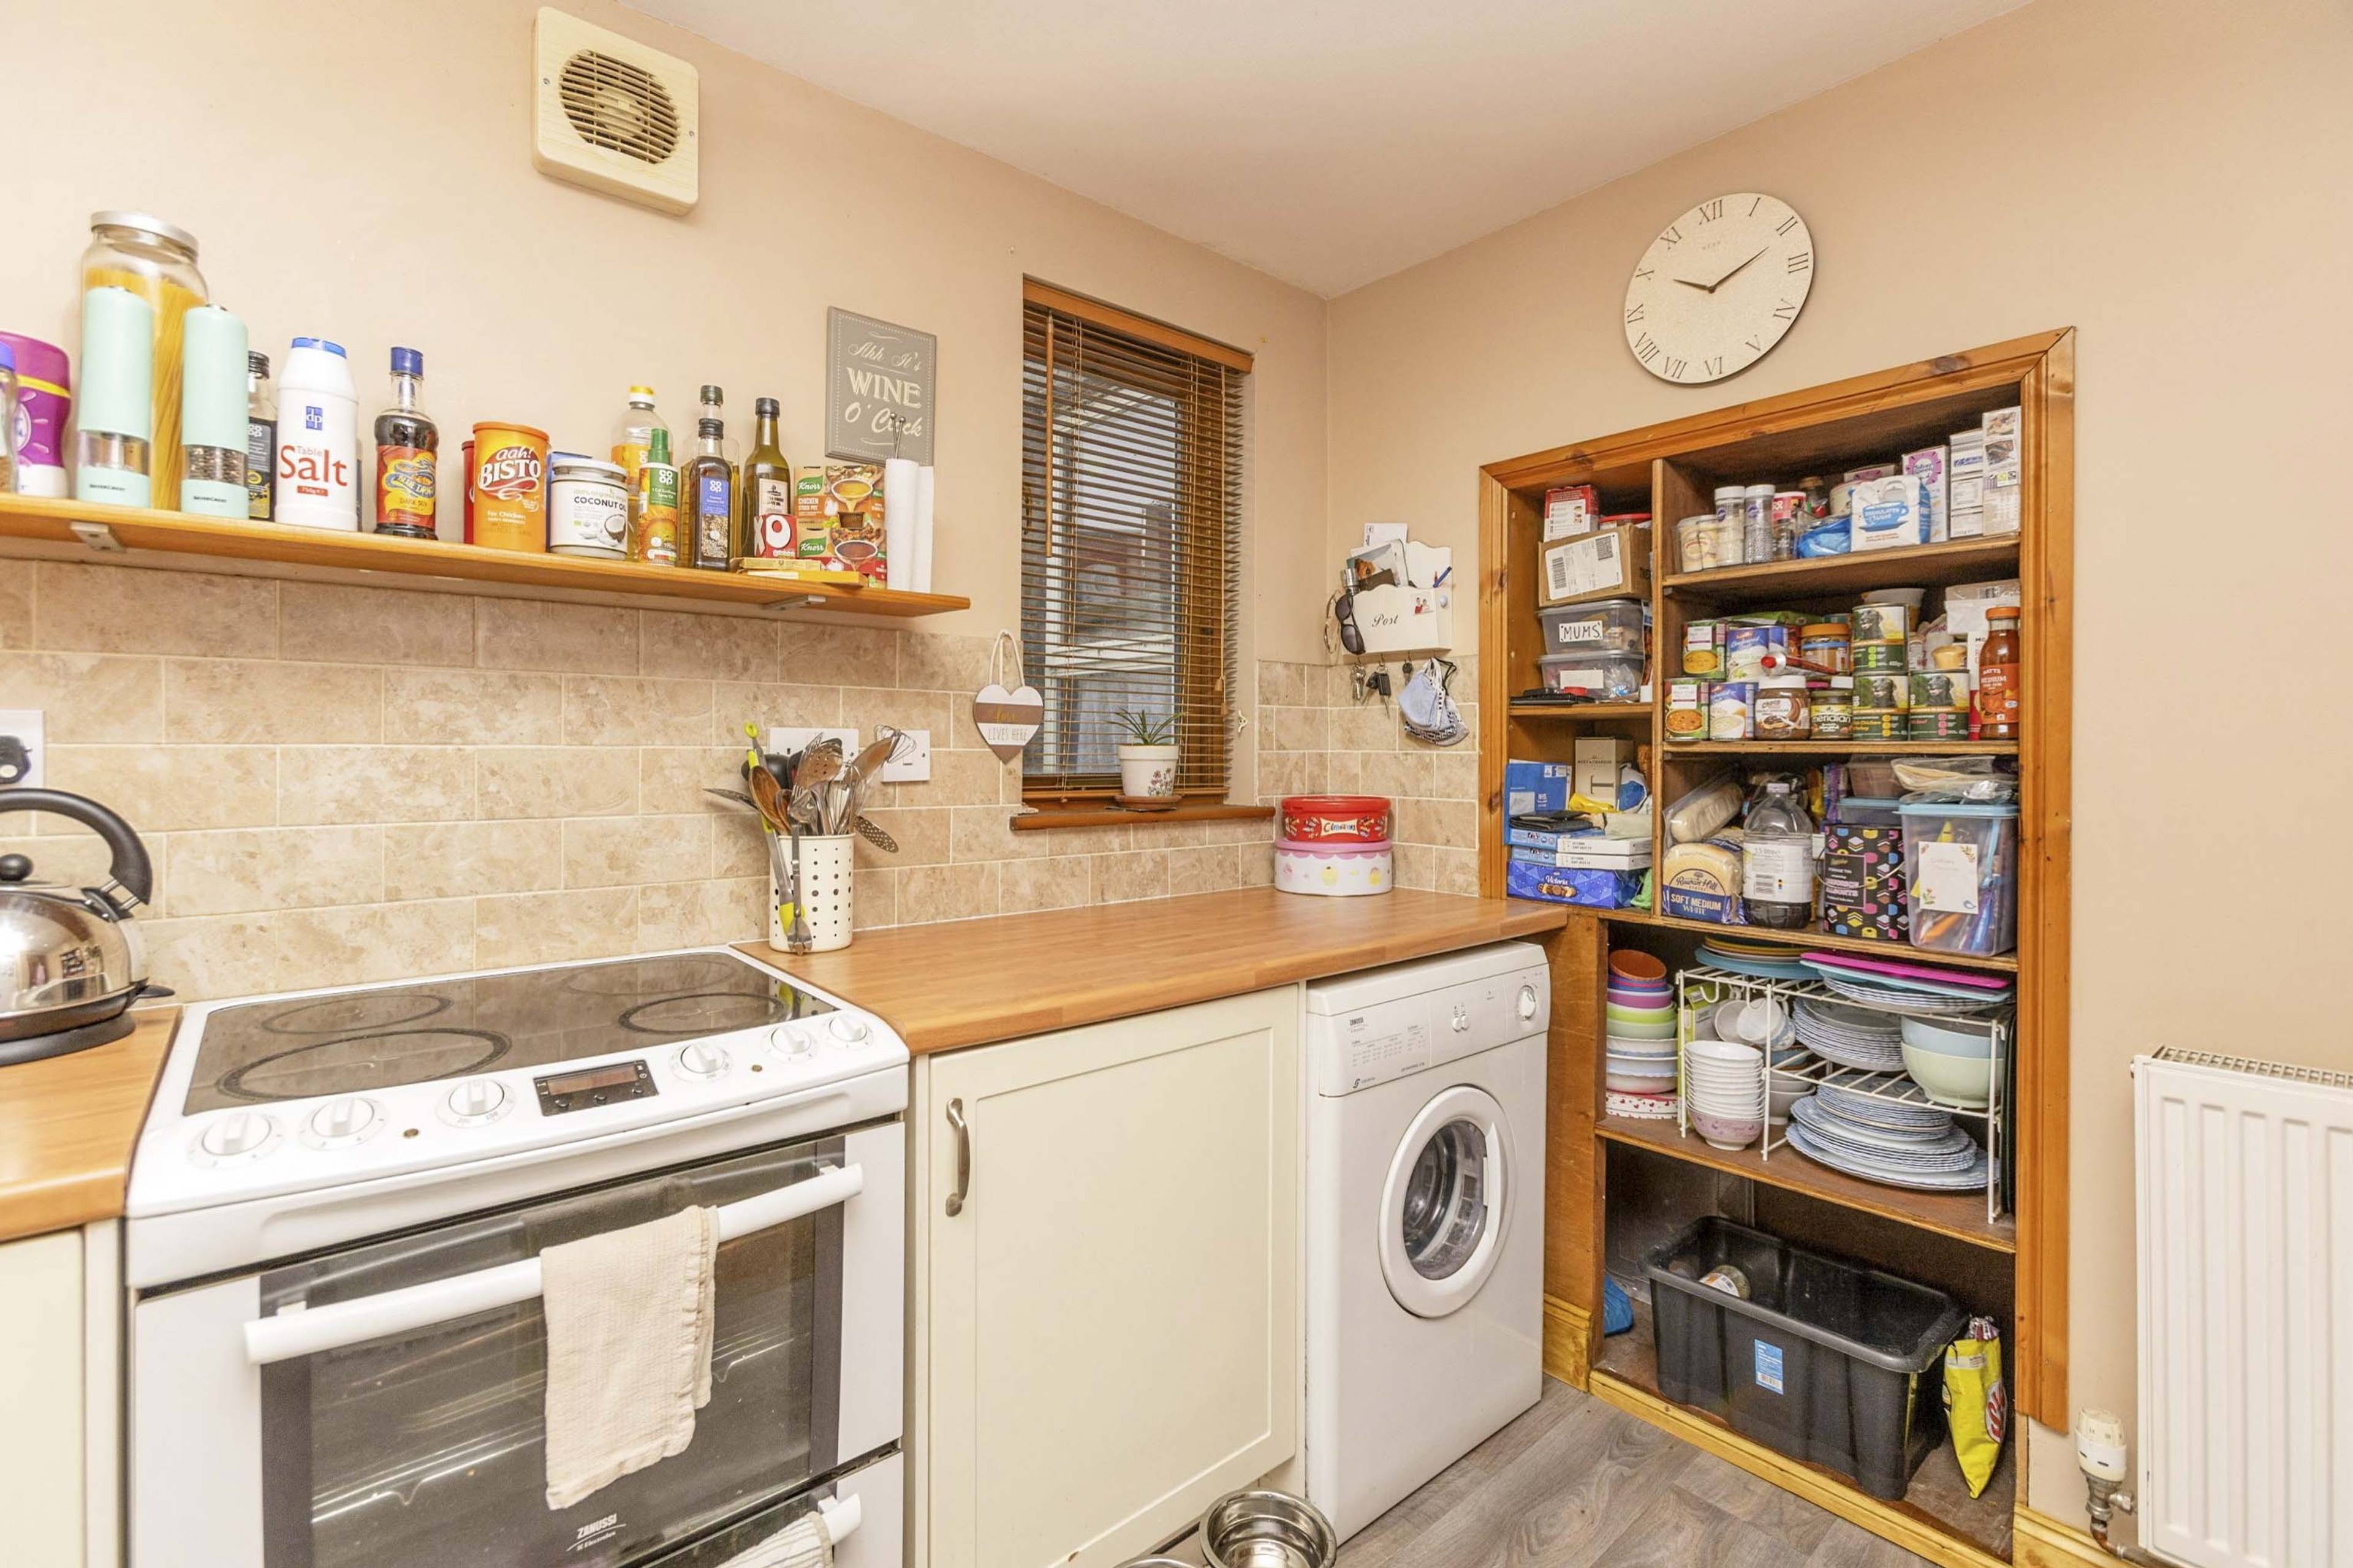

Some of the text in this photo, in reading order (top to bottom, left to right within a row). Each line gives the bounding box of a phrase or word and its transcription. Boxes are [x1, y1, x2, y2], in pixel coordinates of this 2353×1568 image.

[1698, 199, 1723, 225] XII
[1776, 216, 1798, 237] II
[1787, 252, 1809, 275] III
[848, 341, 922, 371] Ahh It's
[1664, 356, 1688, 379] VII
[1704, 356, 1722, 376] VI
[846, 366, 922, 409] WINE
[297, 445, 323, 457] Table
[495, 445, 535, 461] aah!
[279, 444, 348, 487] Salt
[480, 460, 542, 488] BISTO
[798, 481, 822, 491] Knorr
[574, 496, 618, 509] COCONUT
[499, 511, 526, 520] Chicken
[800, 542, 825, 552] Knorr
[1371, 614, 1400, 628] Post
[1563, 624, 1602, 640] MUMS
[1545, 874, 1569, 885] Victoria
[1675, 877, 1700, 887] Rowan
[1670, 893, 1722, 911] SOFT MEDIUM
[577, 1513, 617, 1540] ZANUSSI
